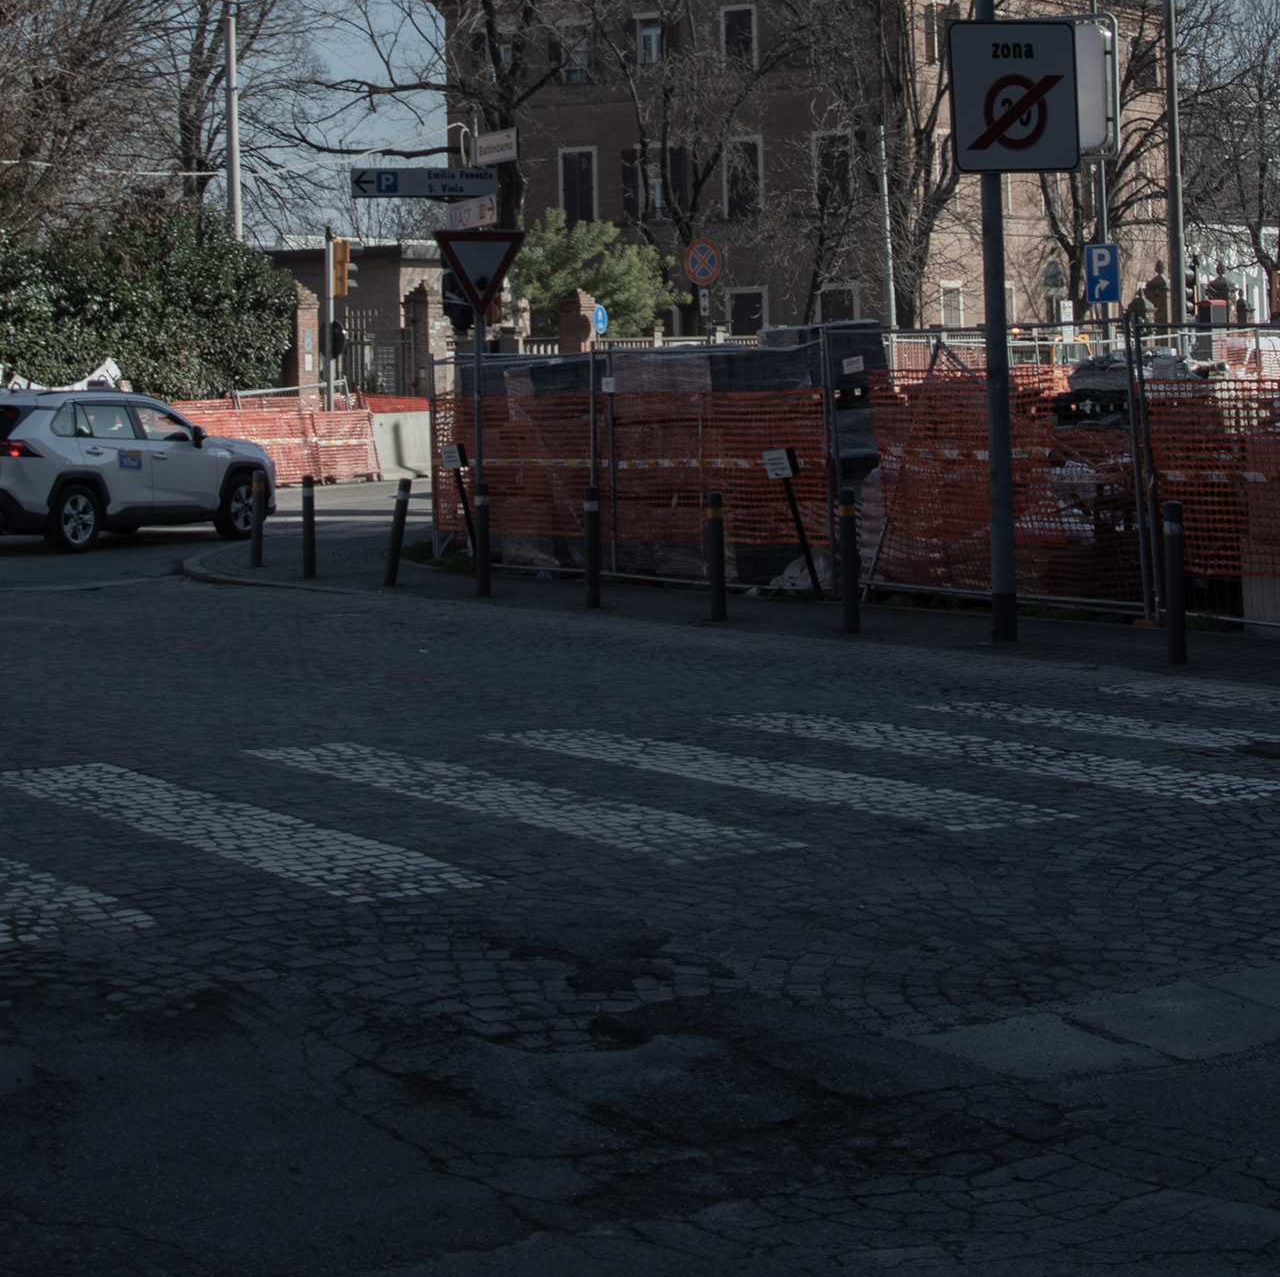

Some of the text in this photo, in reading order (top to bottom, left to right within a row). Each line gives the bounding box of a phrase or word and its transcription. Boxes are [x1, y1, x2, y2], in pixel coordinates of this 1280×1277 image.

[991, 42, 1035, 59] zona
[479, 141, 514, 157] Battindarno
[427, 170, 494, 180] Emilia Ponente
[427, 184, 465, 193] S. Viola
[1092, 248, 1111, 277] P
